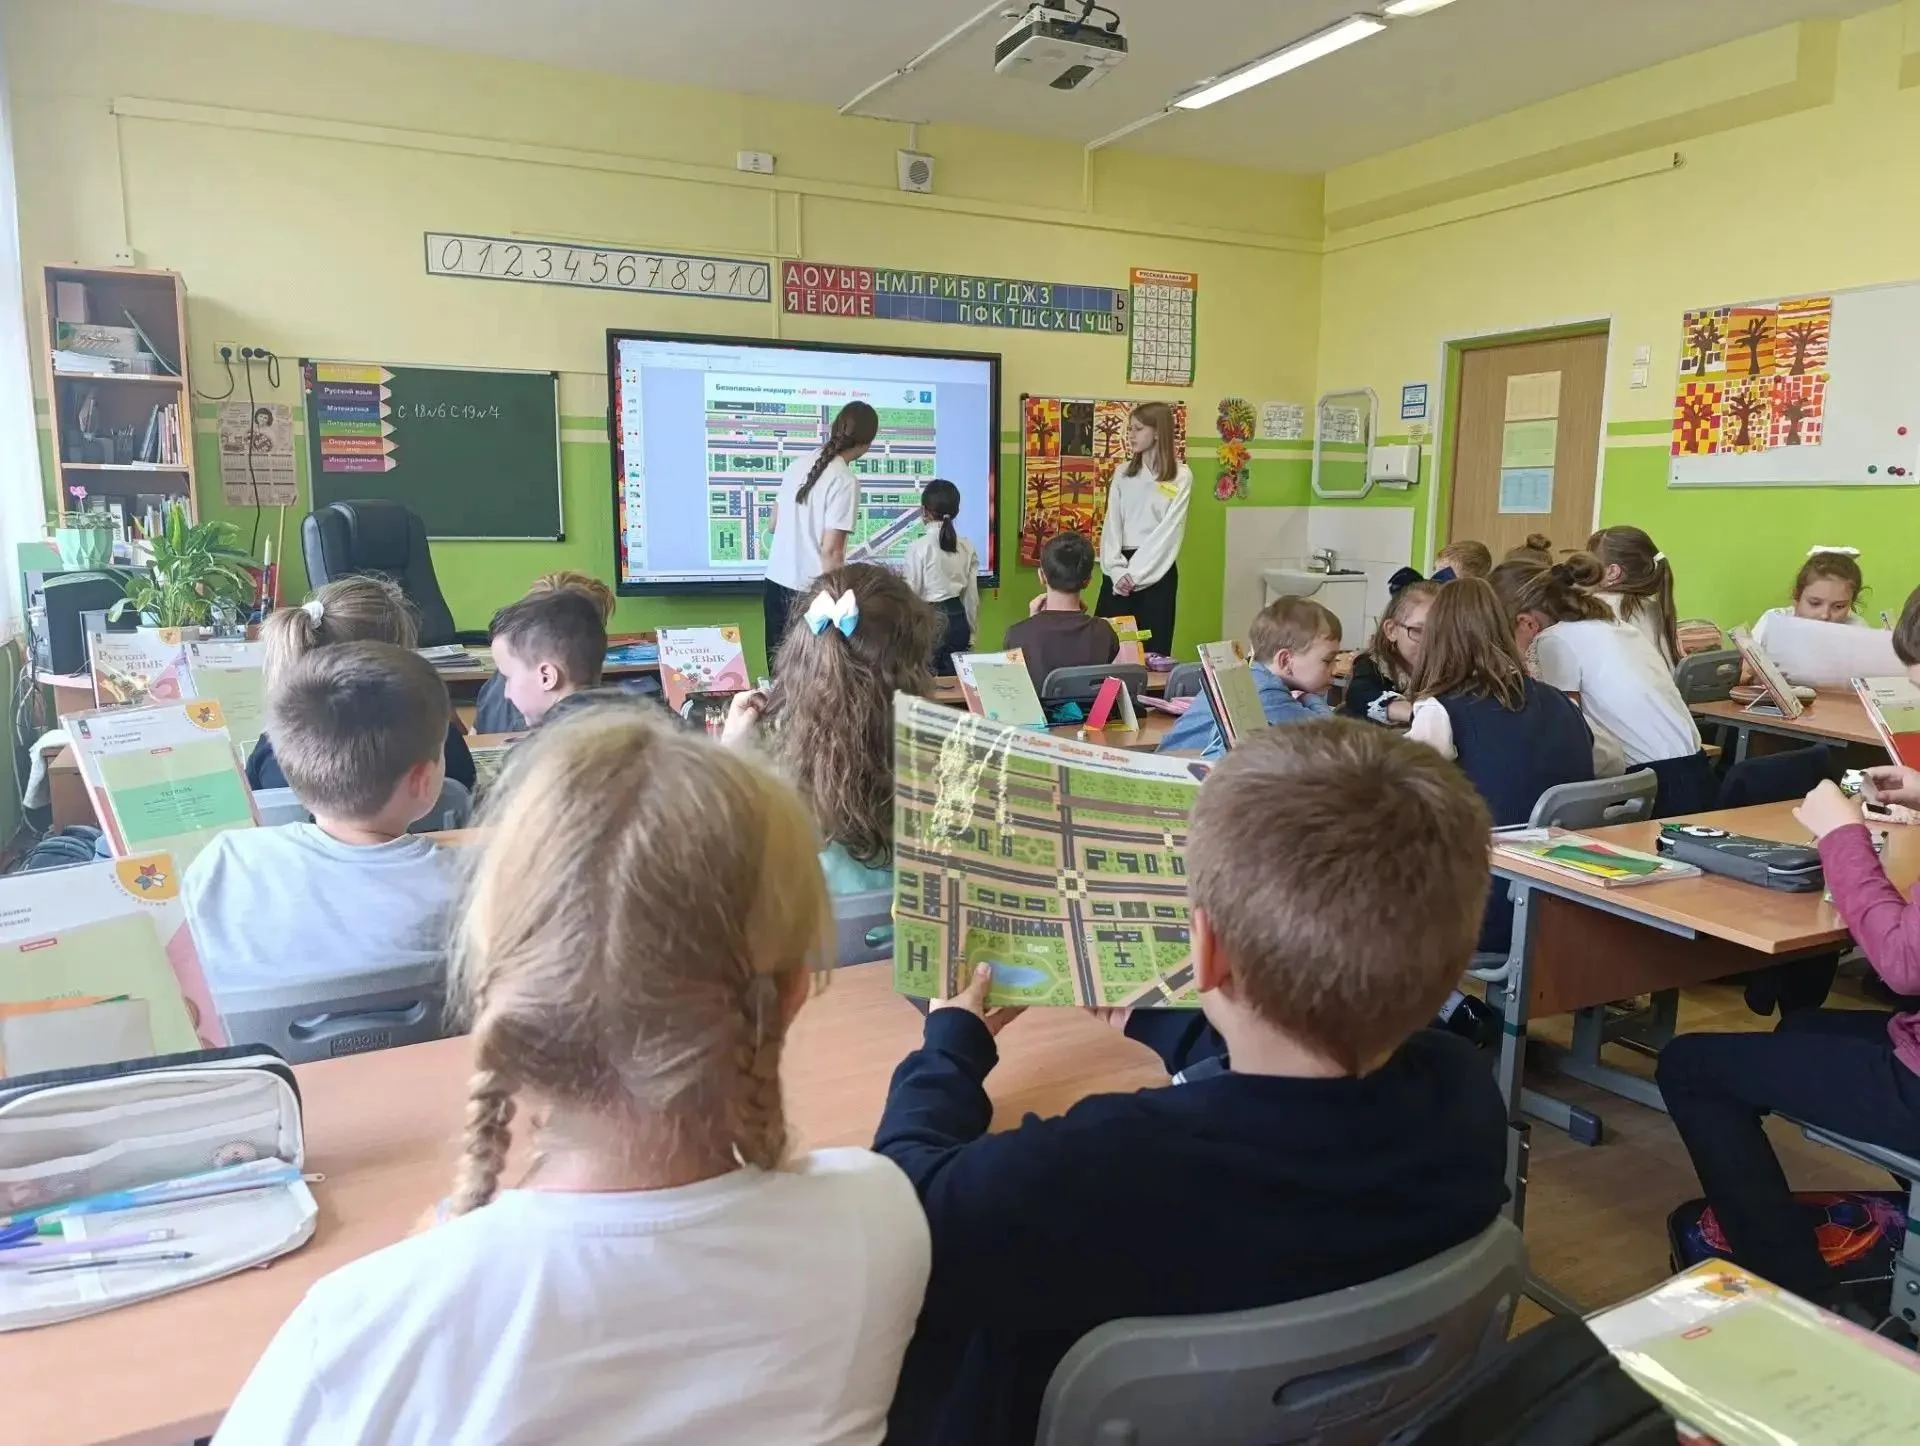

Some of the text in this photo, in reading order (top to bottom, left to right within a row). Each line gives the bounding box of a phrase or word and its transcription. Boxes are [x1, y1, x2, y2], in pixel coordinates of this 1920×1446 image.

[442, 239, 462, 270] 0
[478, 244, 492, 273] 1
[504, 246, 522, 276] 2
[533, 248, 552, 279] 3
[564, 250, 580, 281] 4
[590, 254, 608, 283] 5
[617, 256, 636, 285] 6
[646, 257, 663, 287] 7
[671, 261, 689, 290] 8
[698, 263, 715, 292] 9
